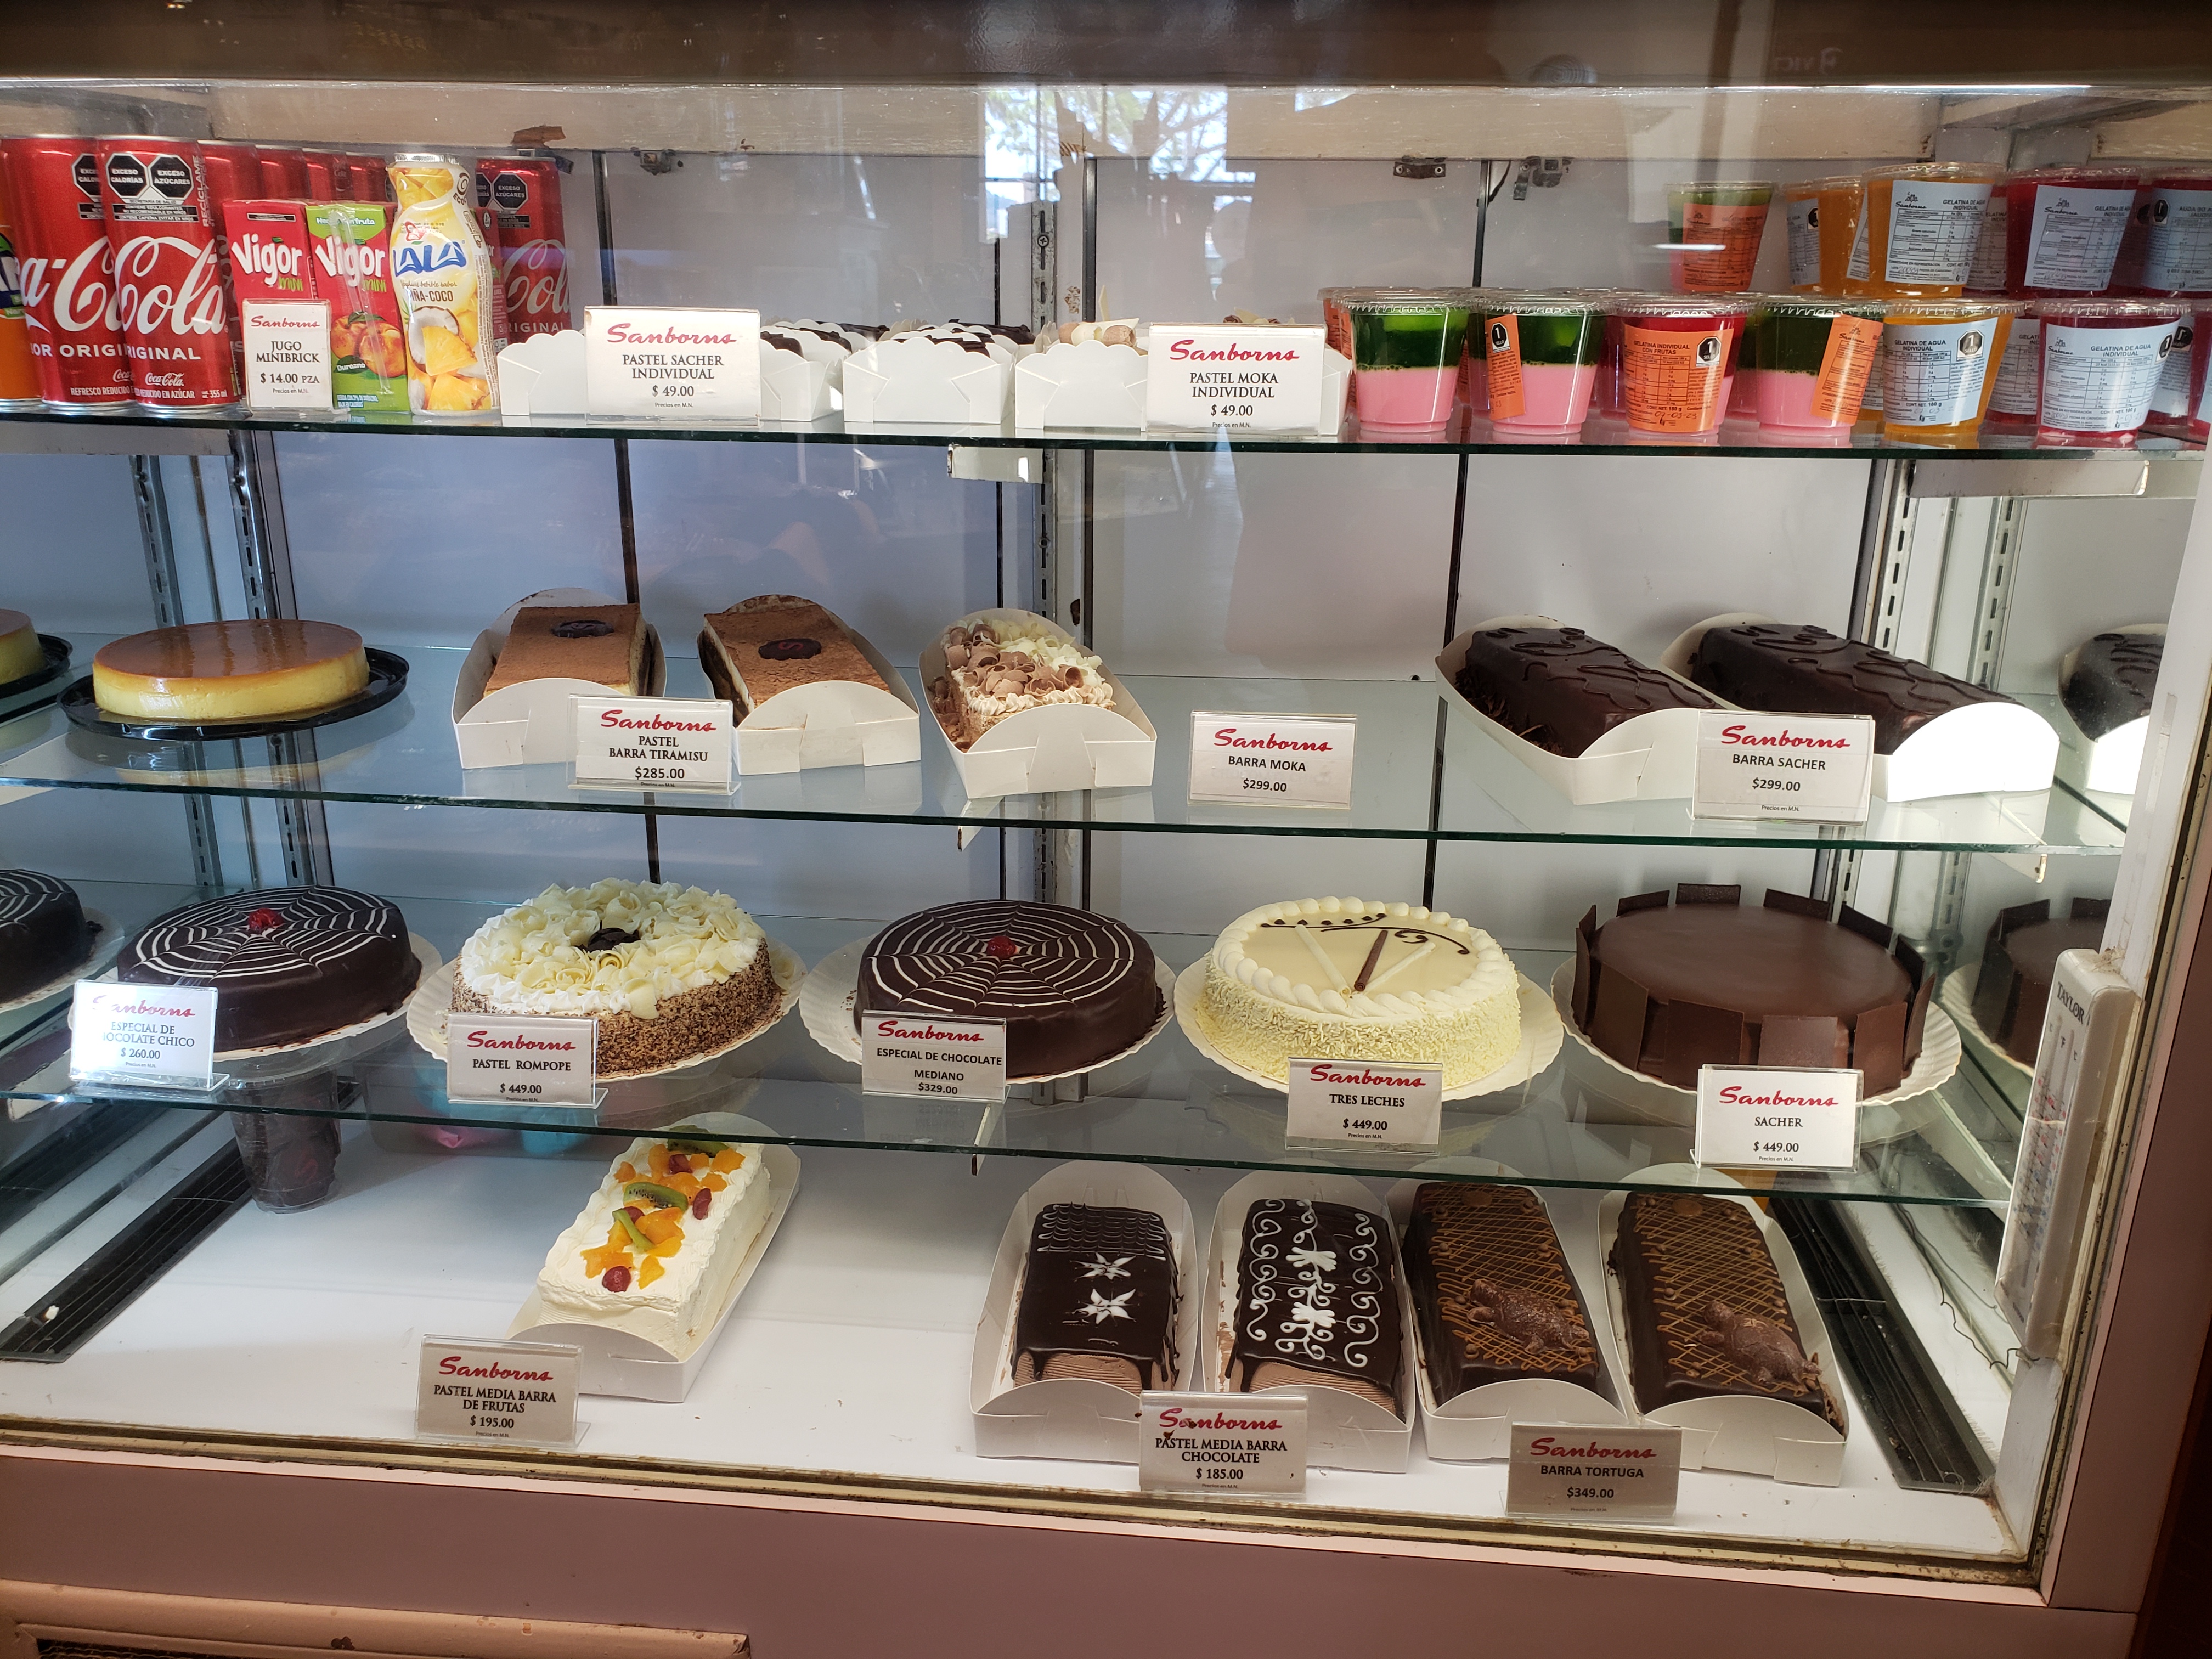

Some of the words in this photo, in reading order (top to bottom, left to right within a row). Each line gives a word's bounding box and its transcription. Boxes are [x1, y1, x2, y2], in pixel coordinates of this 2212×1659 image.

[232, 233, 303, 285] Vigor
[315, 235, 385, 287] Vigor
[393, 241, 467, 278] LALA
[410, 288, 453, 302] IÑA-COCO
[251, 315, 320, 328] Sanborns
[607, 323, 737, 344] Sanborns
[1495, 327, 1500, 339] 1
[1707, 341, 1713, 353] 1
[1968, 334, 1974, 347] 1
[127, 345, 201, 360] RIGINAL
[271, 341, 302, 354] JUGO
[1170, 339, 1300, 362] Sanborns
[256, 353, 320, 363] MINIBRICK
[623, 354, 668, 365] PASTEL
[671, 354, 725, 366] SACHER
[260, 373, 266, 383] $
[270, 373, 298, 383] 14.00
[302, 375, 320, 383] PZA
[632, 368, 715, 379] INDIVIDUAL
[1190, 373, 1234, 384] PASTEL
[1237, 373, 1279, 384] MOKA
[71, 387, 101, 396] REFRESCO
[103, 386, 132, 394] REDUCIDO
[171, 388, 195, 398] AZÚCAR
[210, 390, 219, 398] 355
[221, 389, 227, 397] ml
[652, 385, 658, 397] $
[663, 386, 694, 397] 49.00
[1192, 386, 1275, 398] INDIVIDUAL
[1210, 404, 1217, 417] $
[1221, 405, 1254, 416] 49.00
[600, 709, 717, 732] Sanborns
[639, 736, 679, 747] PASTEL
[1214, 728, 1333, 752] Sanborns
[1721, 725, 1851, 749] Sanborns
[609, 748, 647, 759] BARRA
[650, 749, 709, 761] TIRAMISU
[1228, 755, 1267, 768] BARRA
[1270, 759, 1306, 772] MOKA
[1732, 754, 1774, 766] BARRA
[1778, 757, 1826, 770] SACHER
[635, 766, 685, 780] $285.00
[1243, 777, 1287, 792] $299.00
[1752, 777, 1801, 791] $299.00
[2057, 981, 2084, 1024] TAYLOR
[111, 1022, 158, 1034] ESPECIAL
[160, 1025, 175, 1035] DE
[878, 1020, 985, 1042] Sanborns
[157, 1036, 195, 1047] CHICO
[467, 1030, 576, 1051] Sanborns
[121, 1047, 126, 1057] $
[129, 1048, 160, 1059] 260.00
[877, 1048, 923, 1059] ESPECIAL
[926, 1052, 938, 1060] DE
[941, 1053, 1002, 1065] CHOCOLATE
[473, 1059, 511, 1069] PASTEL
[516, 1060, 571, 1071] ROMPOPE
[914, 1070, 964, 1081] MEDIANO
[1310, 1064, 1426, 1087] Sanborns
[500, 1083, 505, 1093] $
[509, 1084, 542, 1094] 449.00
[918, 1082, 958, 1094] $329.00
[1329, 1093, 1358, 1104] TRES
[1361, 1096, 1405, 1107] LECHES
[1719, 1086, 1839, 1107] Sanborns
[1342, 1118, 1349, 1129] $
[1352, 1119, 1388, 1130] 449.00
[1754, 1116, 1804, 1127] SACHER
[1753, 1141, 1759, 1152] $
[1763, 1142, 1799, 1152] 449.00
[438, 1356, 554, 1381] Sanborns
[434, 1384, 473, 1397] PASTEL
[476, 1387, 516, 1400] MEDIA
[518, 1390, 557, 1403] BARRA
[462, 1399, 479, 1410] DE
[482, 1401, 525, 1413] FRUTAS
[470, 1415, 476, 1426] $
[480, 1417, 514, 1429] 195.00
[1159, 1408, 1283, 1430] Sanborns
[1155, 1437, 1198, 1449] PASTEL
[1201, 1439, 1244, 1450] MEDIA
[1246, 1440, 1288, 1451] BARRA
[1530, 1437, 1657, 1459] Sanborns
[1181, 1451, 1260, 1463] CHOCOLATE
[1196, 1467, 1203, 1479] $
[1206, 1468, 1244, 1480] 185.00
[1540, 1465, 1582, 1476] BARRA
[1585, 1466, 1644, 1479] TORTUGA
[1567, 1486, 1614, 1498] $349.00
